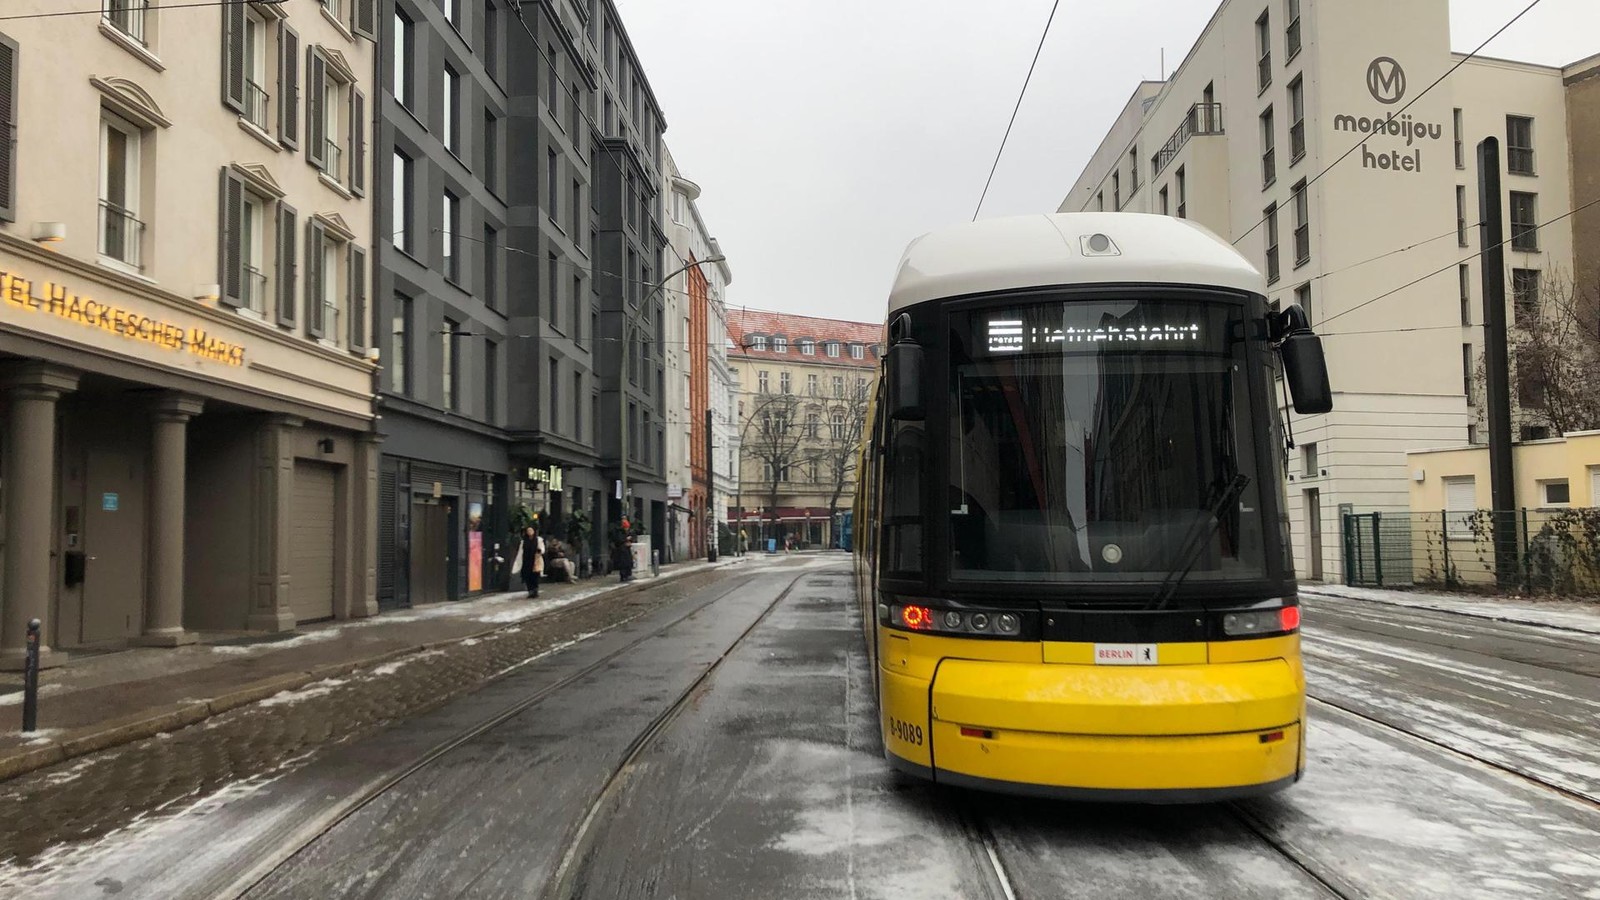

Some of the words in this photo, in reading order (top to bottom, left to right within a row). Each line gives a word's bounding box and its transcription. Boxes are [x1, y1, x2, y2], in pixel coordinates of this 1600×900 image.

[1334, 112, 1441, 146] monbijou
[1362, 144, 1421, 172] hotel
[49, 282, 185, 350] HACKESCHER
[191, 328, 247, 366] MARKT
[1098, 649, 1133, 660] BERLIN
